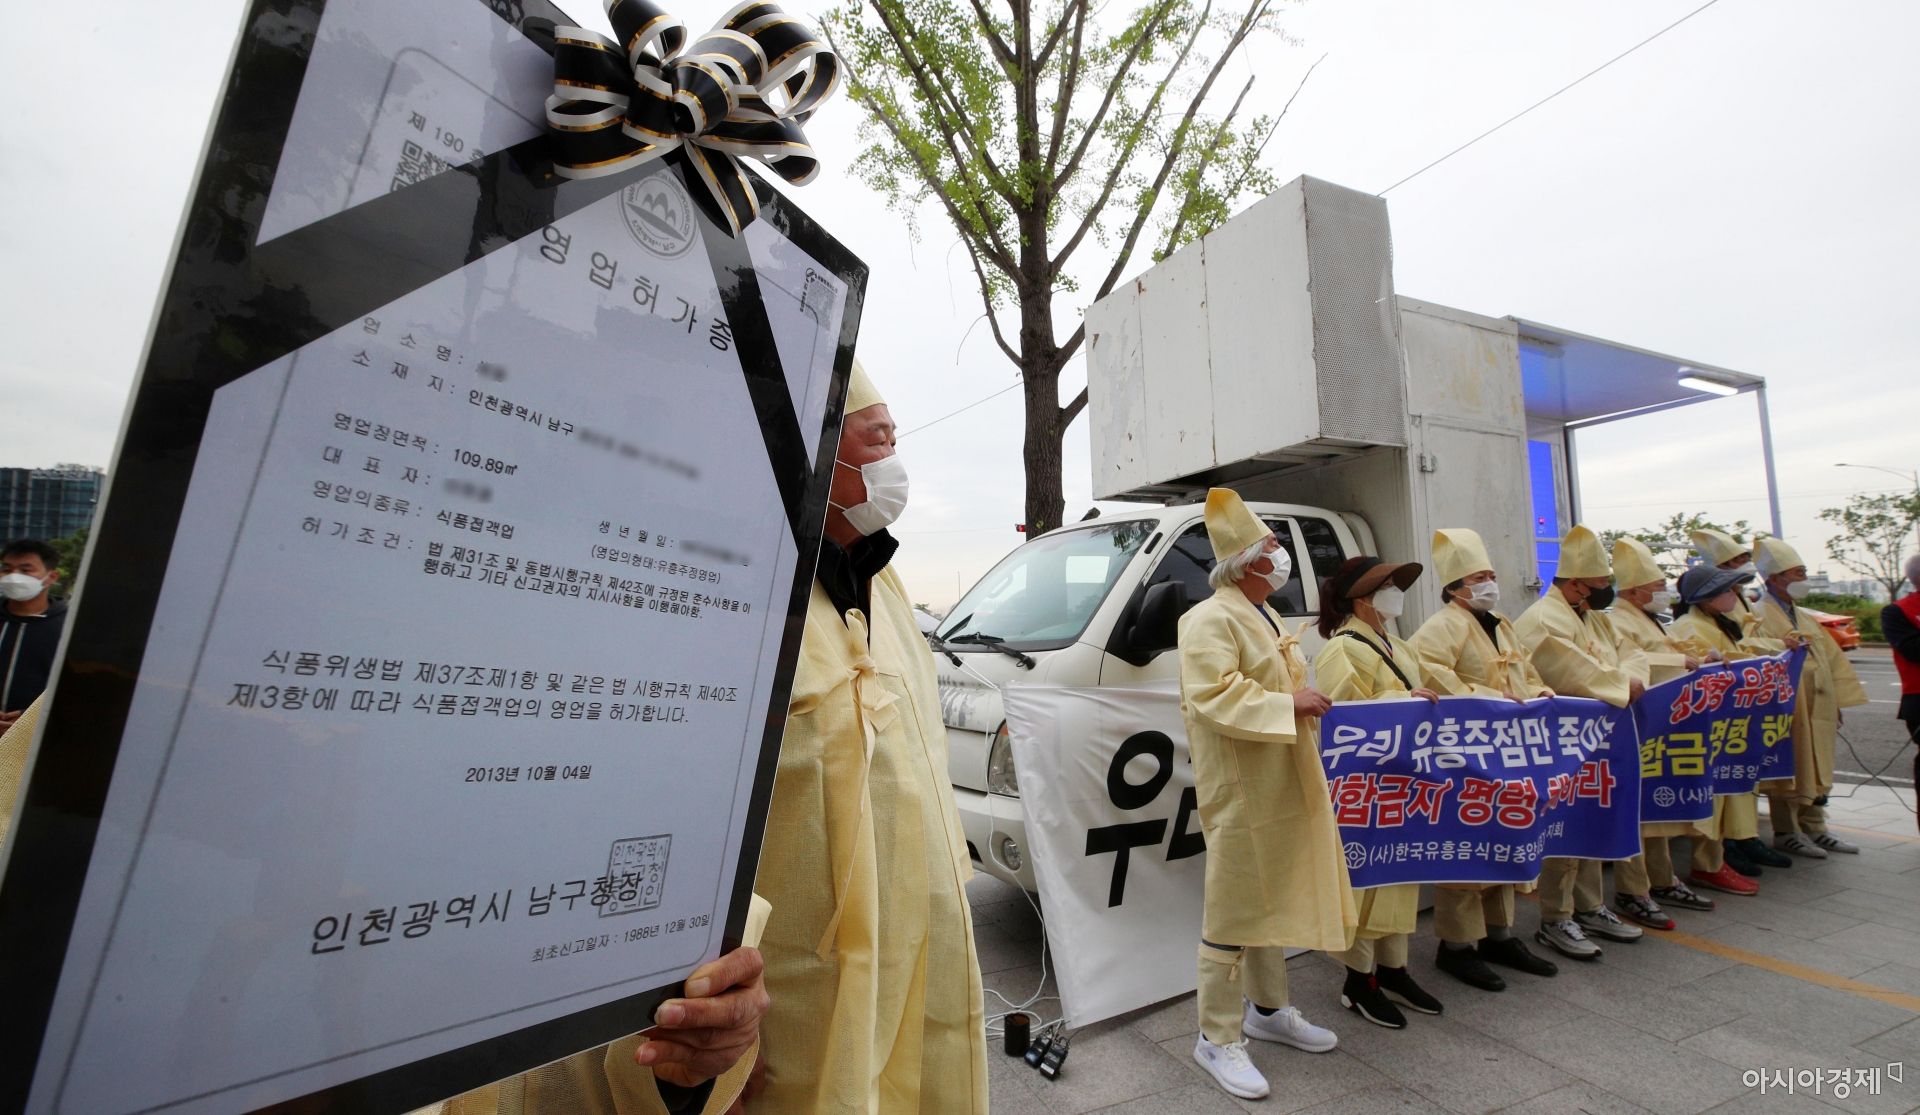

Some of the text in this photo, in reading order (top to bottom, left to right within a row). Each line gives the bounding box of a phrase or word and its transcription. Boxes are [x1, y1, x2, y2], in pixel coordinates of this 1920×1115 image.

[434, 127, 464, 152] 190
[468, 389, 575, 436] 인천광역시 남구
[436, 508, 515, 540] 식품접객업
[423, 558, 473, 580] 행하고
[478, 567, 508, 587] 기타
[513, 574, 582, 599] 신고권자의
[587, 587, 646, 609] 지시사항을
[428, 541, 443, 558] 법
[450, 545, 500, 568] 제31조
[524, 560, 603, 588] 동법시행규칙
[608, 575, 655, 597] 제42조에
[261, 649, 739, 703] 식품위생법 제37조제1항 및 같은 법 시행규칙 제40조
[226, 682, 689, 724] 제3항에 따라 식품접객업의 영업을 허가합니다.
[1322, 724, 1402, 770] 우리
[1410, 717, 1553, 774] 유흥주점만
[464, 764, 592, 783] 2013년 10월 04일
[1328, 772, 1455, 829] 합금지
[1457, 775, 1540, 829] 명령
[310, 871, 644, 956] 인천광역시 남구청장
[624, 924, 660, 943] 1988년
[664, 919, 686, 935] 12월
[689, 913, 711, 929] 30일
